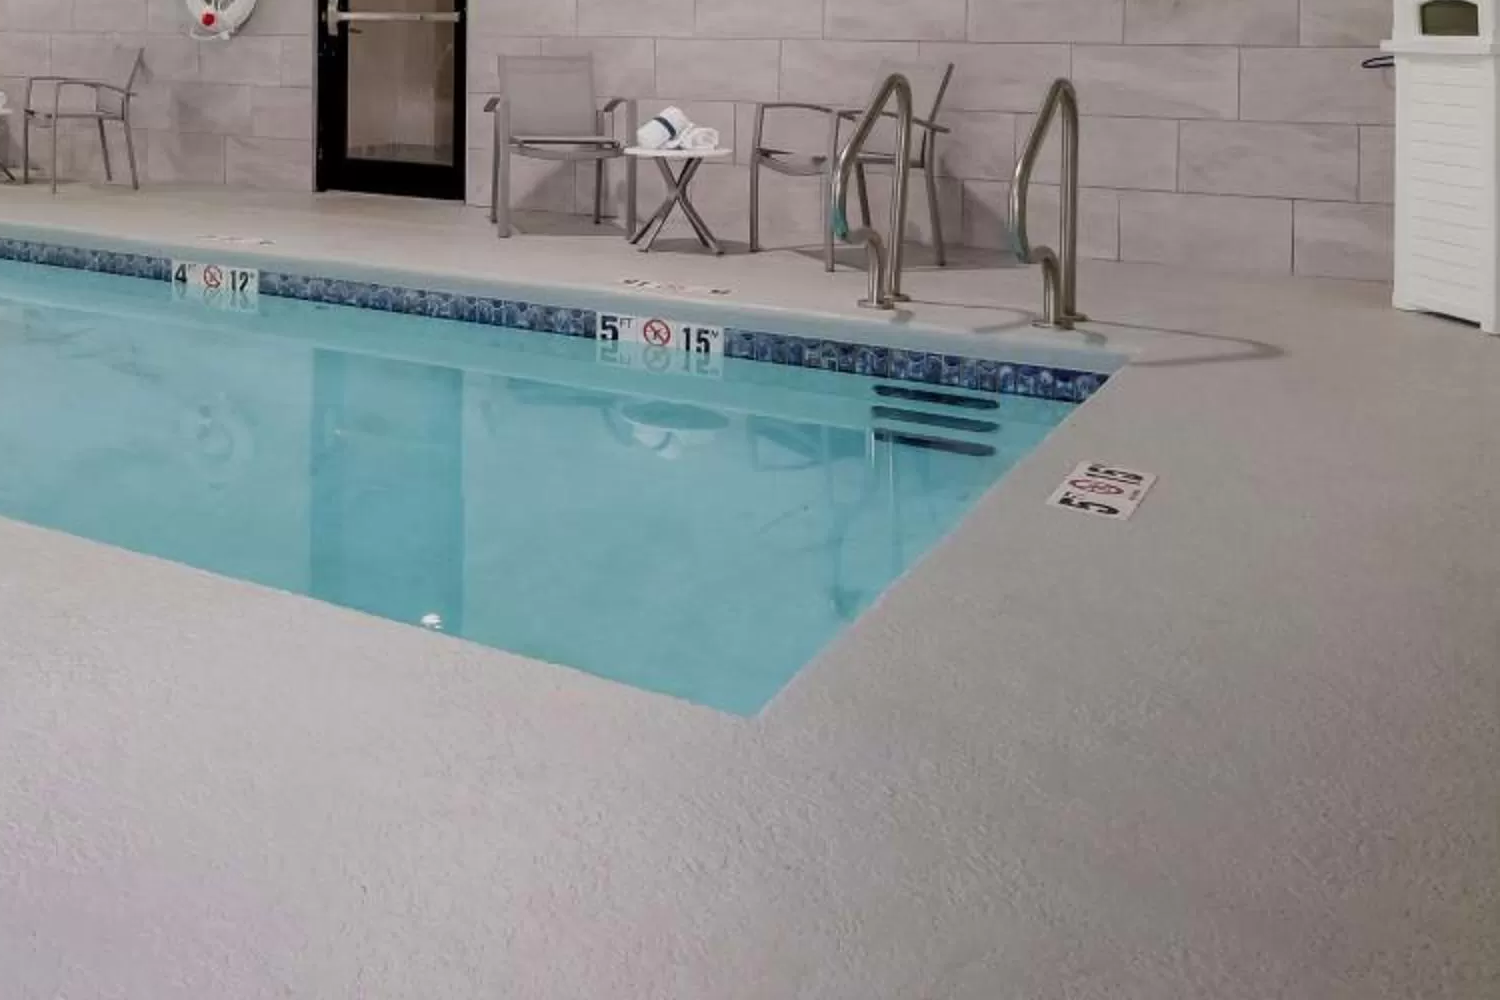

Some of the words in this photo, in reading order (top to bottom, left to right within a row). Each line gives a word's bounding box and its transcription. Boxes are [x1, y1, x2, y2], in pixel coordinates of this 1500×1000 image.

[175, 264, 188, 284] 4
[230, 270, 249, 292] 12
[601, 315, 619, 341] 5
